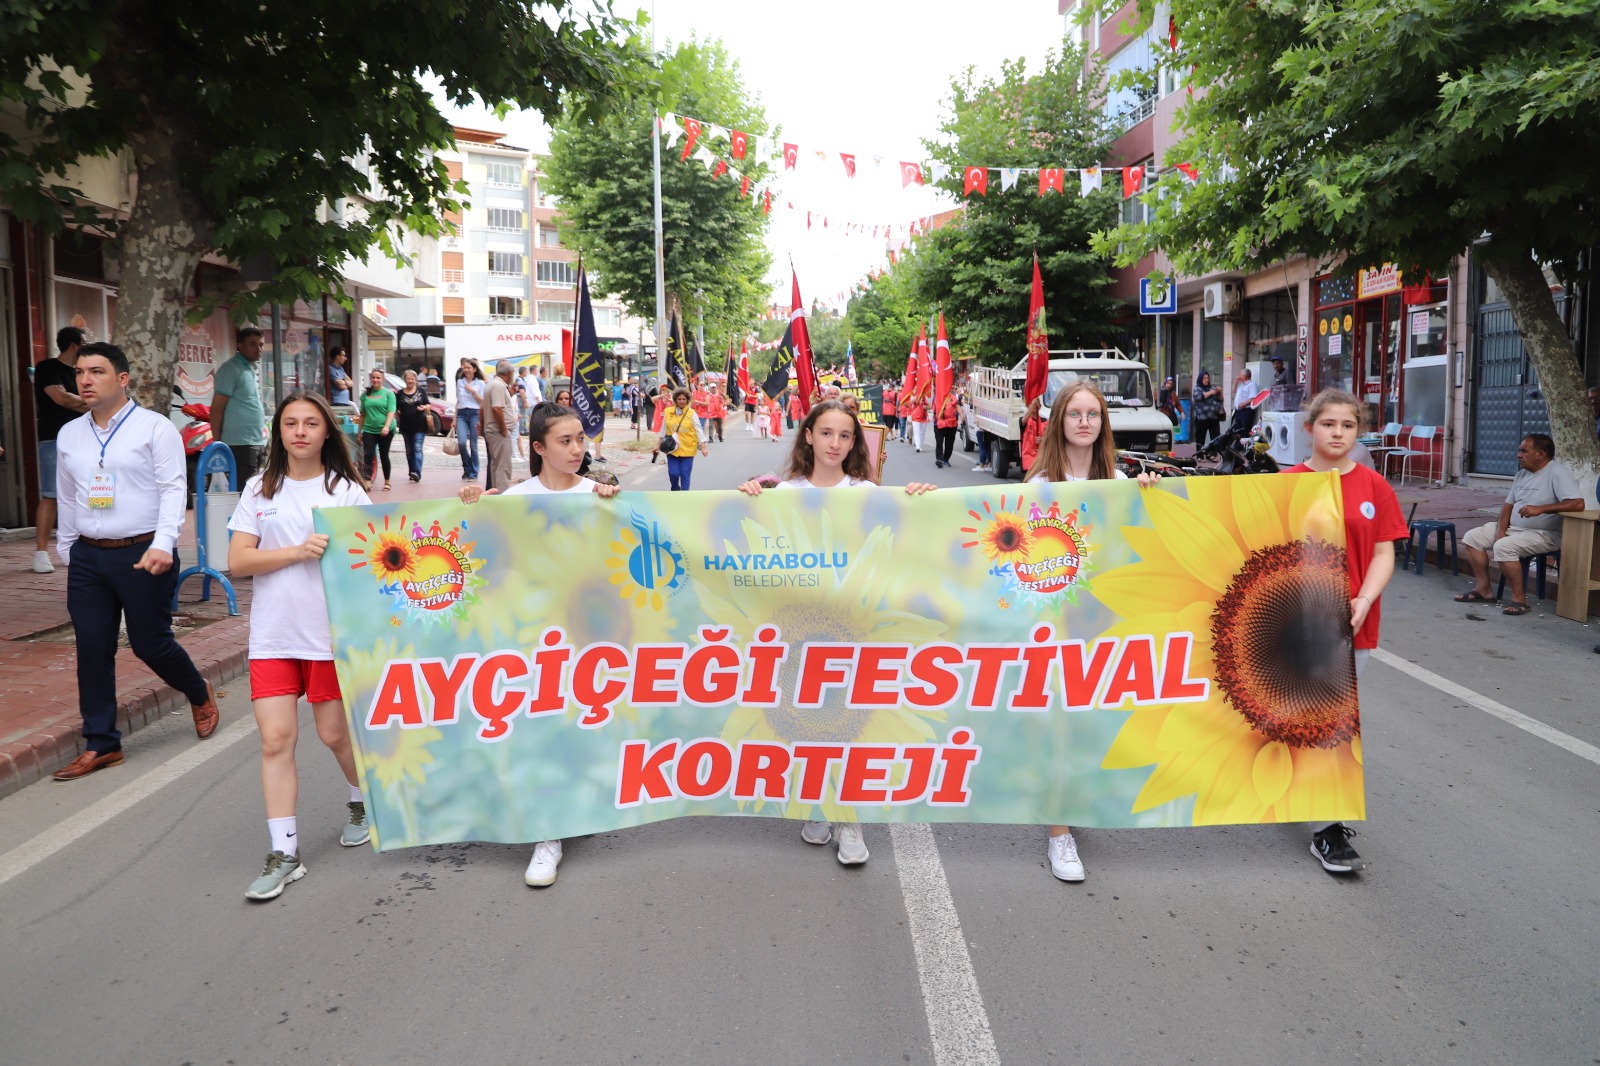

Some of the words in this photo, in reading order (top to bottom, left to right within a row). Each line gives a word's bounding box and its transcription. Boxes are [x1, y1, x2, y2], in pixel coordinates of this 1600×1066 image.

[179, 344, 213, 363] BERKE
[761, 536, 790, 549] T.C.
[1028, 518, 1087, 557] HAYRABOLU
[411, 536, 472, 573] HAYRABOLU
[704, 552, 848, 570] HAYRABOLU
[1017, 552, 1079, 577] AYÇİÇEĞİ
[405, 570, 463, 595] AYÇİÇEĞİ
[1017, 574, 1078, 591] FESTİVALİ
[407, 590, 465, 608] FESTİVALİ
[367, 625, 787, 740] AYÇİÇEĞİ
[796, 624, 1208, 709] FESTİVAL
[617, 728, 979, 806] KORTEJİ
